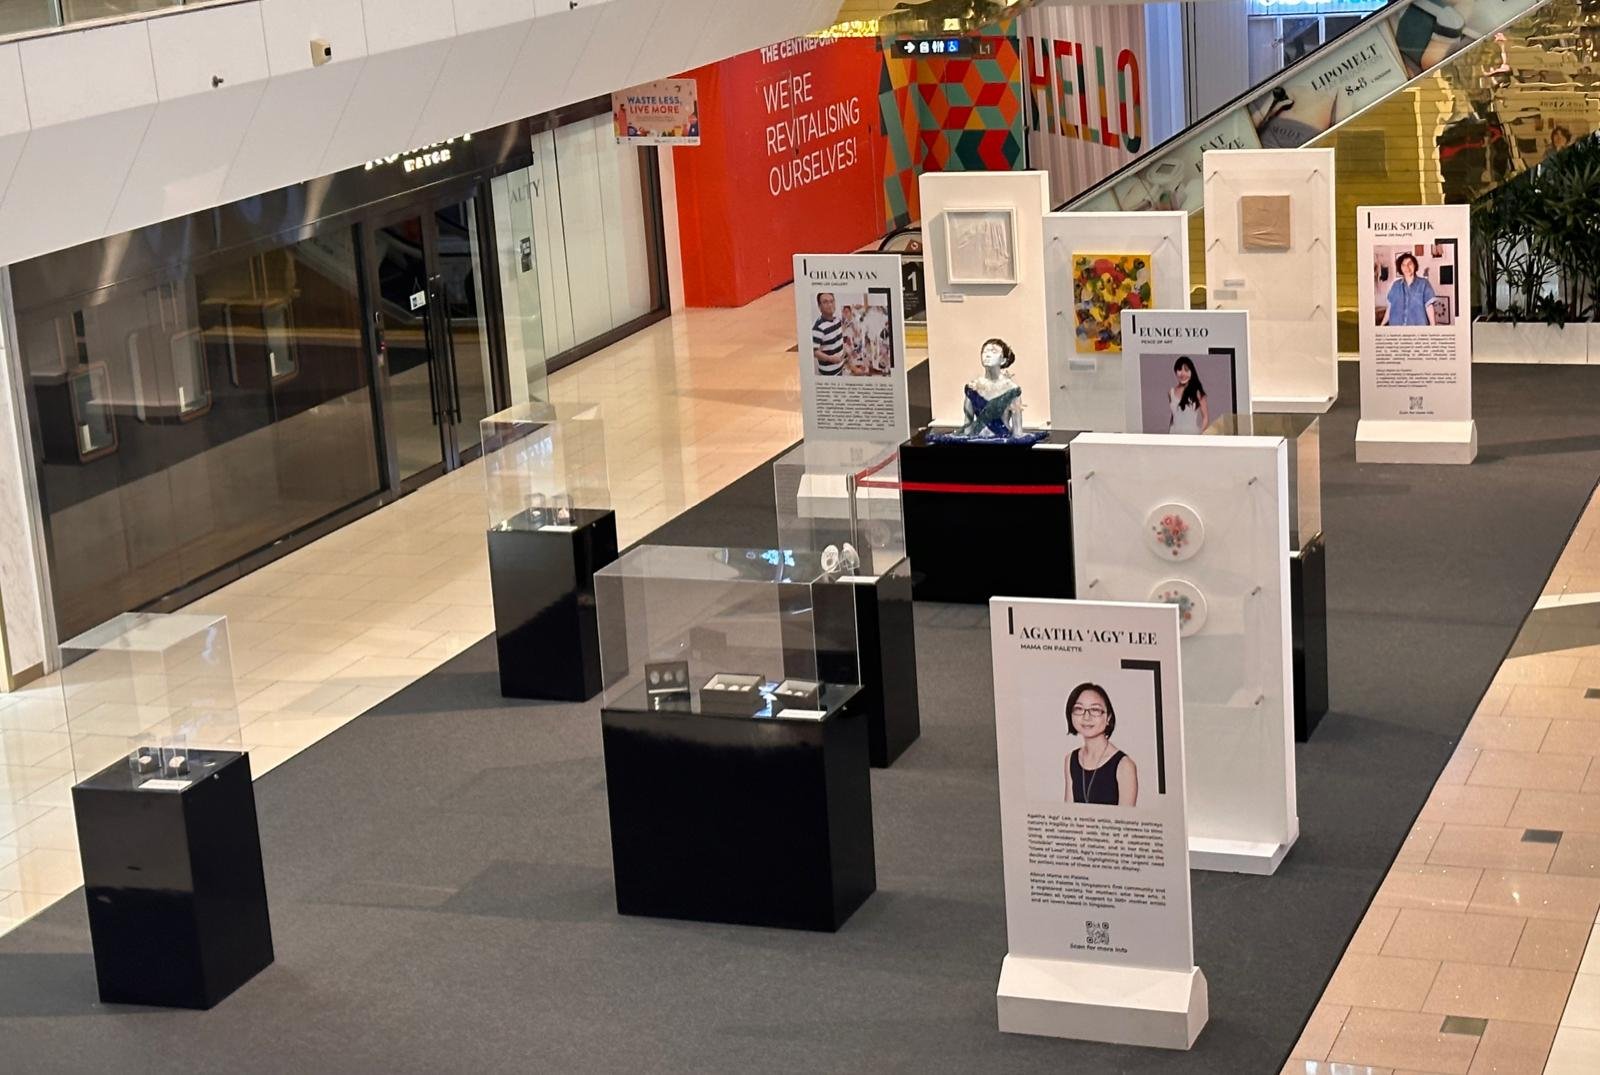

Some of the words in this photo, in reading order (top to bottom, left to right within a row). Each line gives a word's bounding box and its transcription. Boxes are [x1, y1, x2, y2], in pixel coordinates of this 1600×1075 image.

[760, 46, 779, 65] THE
[979, 44, 992, 54] L1
[1311, 43, 1377, 91] LIPOMELT
[627, 96, 655, 105] WASTE
[763, 72, 813, 115] WE'RE
[1026, 36, 1142, 154] HELLO
[630, 105, 649, 114] LIVE
[652, 105, 680, 114] MORE
[766, 97, 860, 157] REVITALISING
[769, 137, 858, 196] OURSELVES!
[809, 270, 838, 280] CHUA
[839, 270, 856, 280] ZIN
[857, 271, 878, 280] YAN
[1139, 327, 1182, 337] EUNICE
[1184, 327, 1209, 338] YEO
[1019, 626, 1084, 642] AGATHA
[1086, 629, 1125, 644] 'AGY'
[1128, 631, 1157, 646] LEE
[1020, 643, 1042, 651] MAMA
[1054, 645, 1083, 653] PALETTE
[1069, 941, 1086, 949] Scan
